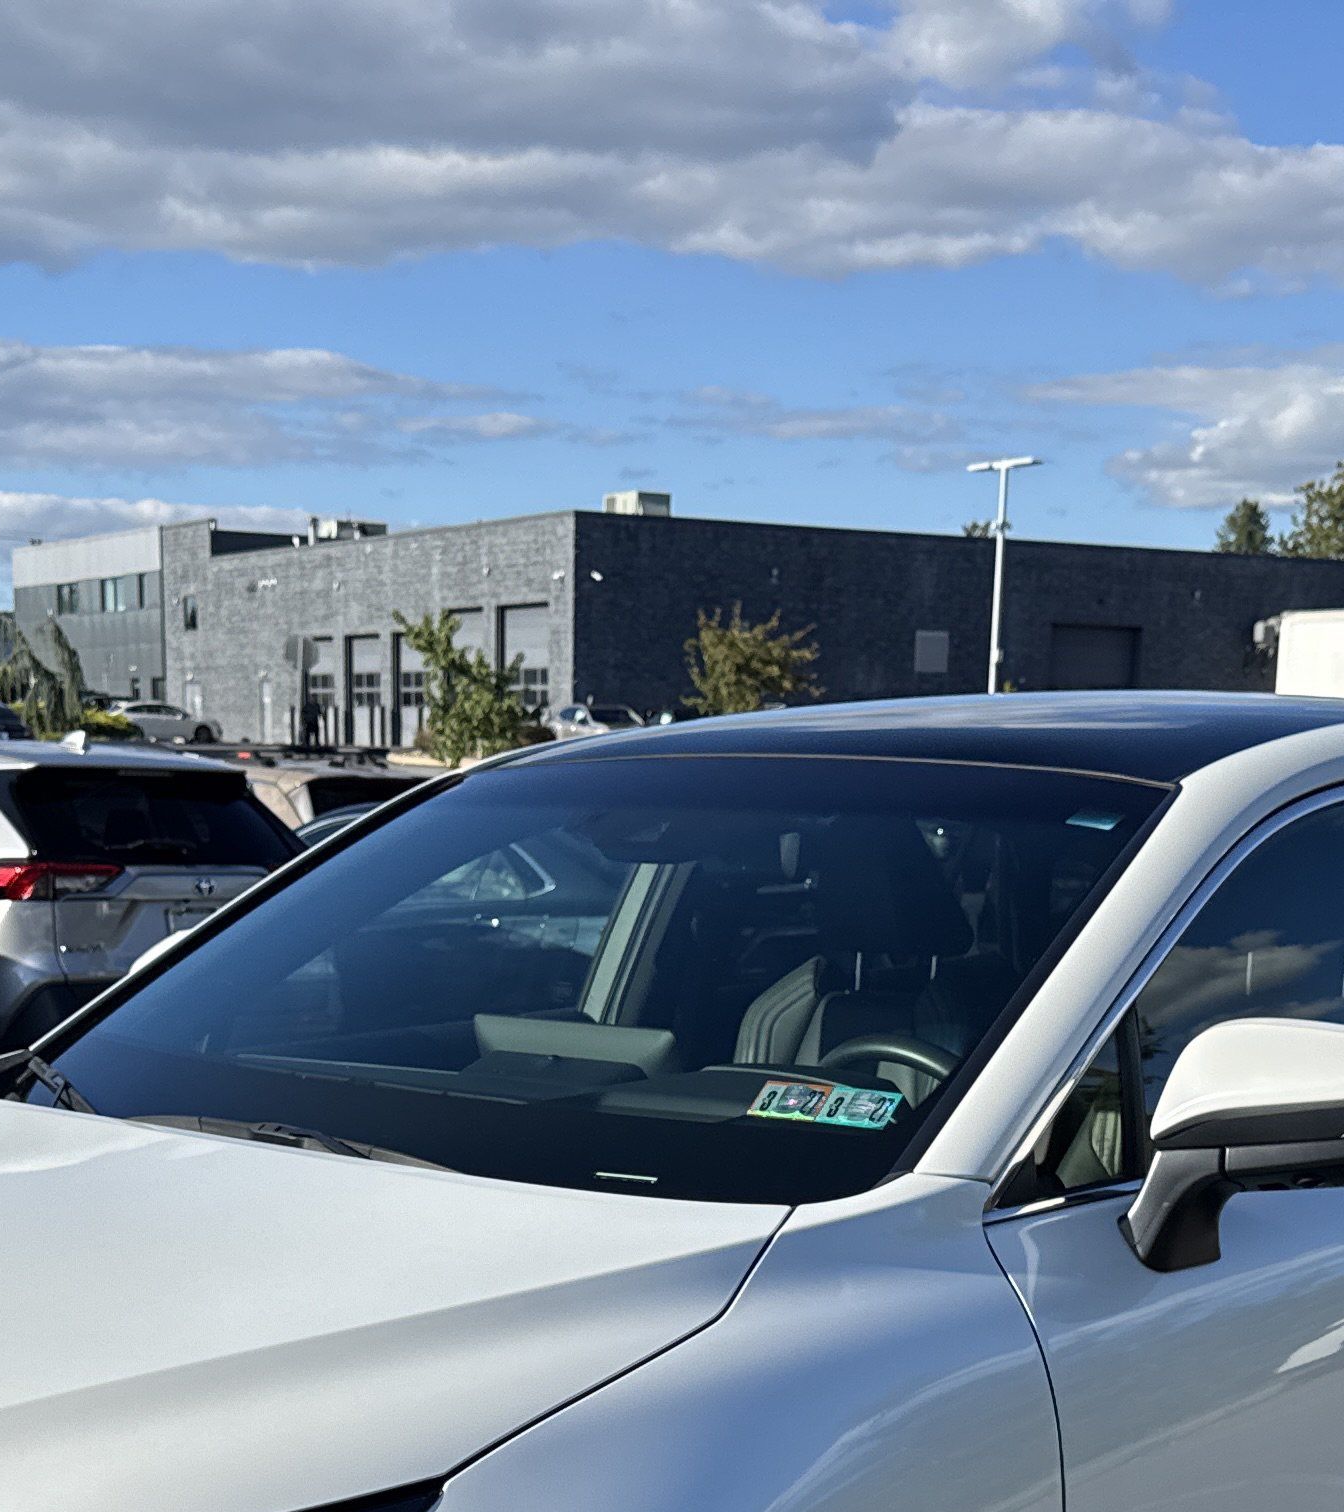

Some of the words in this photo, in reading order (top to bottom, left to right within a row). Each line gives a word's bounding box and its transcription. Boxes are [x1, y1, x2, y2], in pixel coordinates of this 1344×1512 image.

[759, 1090, 778, 1111] 3
[826, 1096, 845, 1118] 3
[869, 1096, 896, 1123] 27
